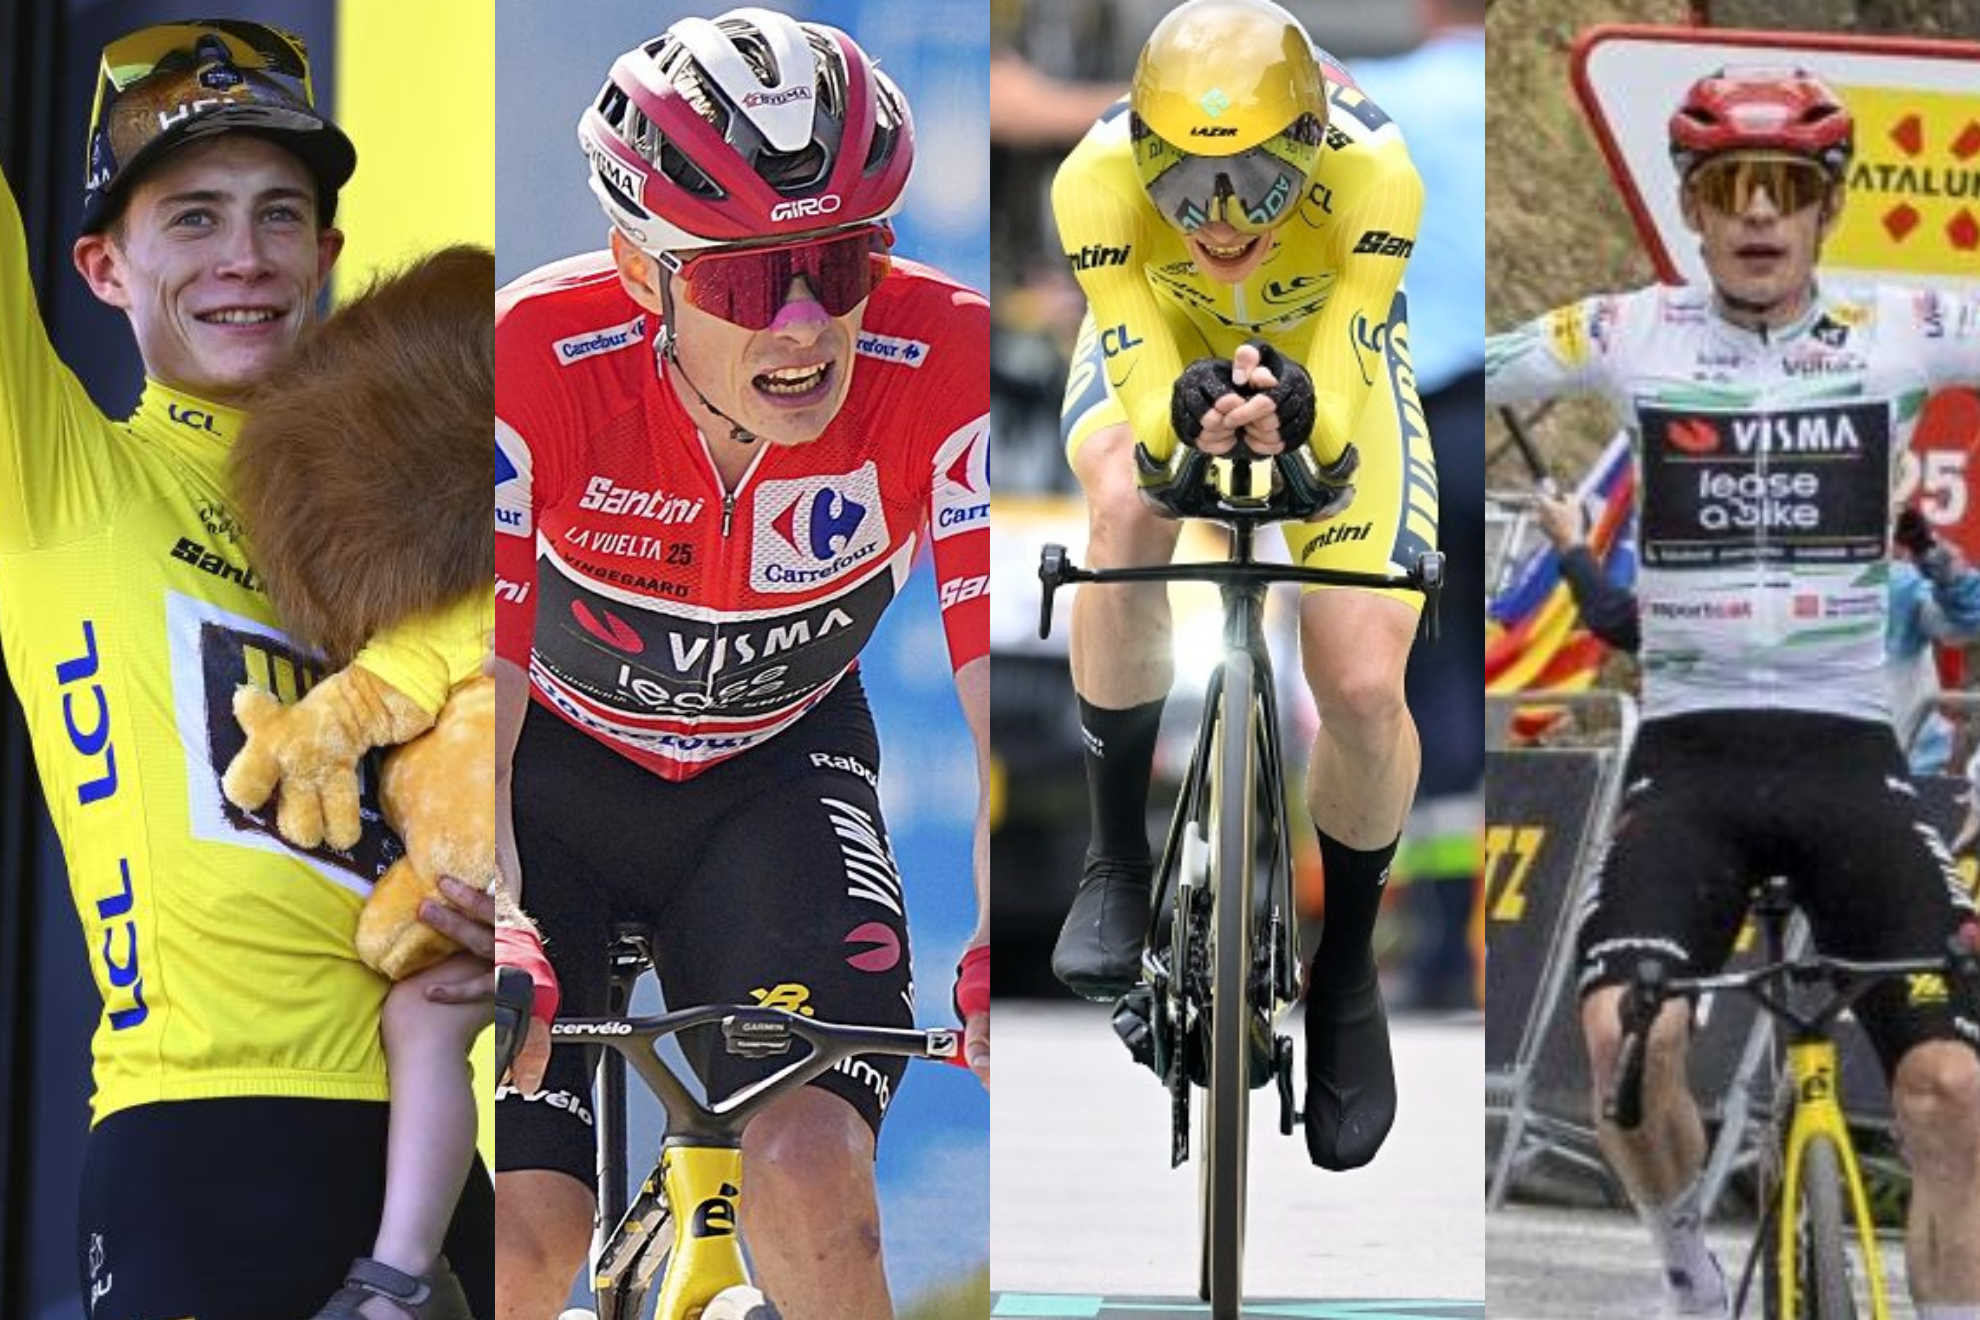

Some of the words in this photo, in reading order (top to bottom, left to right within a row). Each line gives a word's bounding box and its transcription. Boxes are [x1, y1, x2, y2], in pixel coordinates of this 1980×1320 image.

[1190, 126, 1239, 137] LAZER
[1850, 164, 1980, 198] ATALU
[771, 194, 841, 222] GIRO
[1066, 242, 1132, 270] ntini
[562, 333, 628, 358] Carrefour
[857, 338, 899, 357] refour
[1102, 323, 1144, 358] CL
[1358, 315, 1386, 352] LC
[168, 403, 223, 437] LCL
[1732, 414, 1860, 452] VISMA
[578, 475, 705, 526] Santini
[1700, 469, 1820, 500] lease
[938, 503, 990, 528] Carr
[564, 526, 590, 548] LA
[591, 532, 661, 561] VUELTA
[666, 542, 694, 567] 25
[763, 540, 879, 584] Carrefour
[170, 536, 267, 594] Sant
[564, 551, 689, 598] VINGEGAARD
[941, 574, 990, 612] Sa
[668, 606, 855, 674] VISMA
[56, 620, 118, 806] LCL
[809, 752, 878, 788] Rabo
[96, 857, 150, 1032] LCL
[551, 1022, 633, 1036] cervélo
[742, 1023, 785, 1031] GARMIN
[495, 1085, 593, 1127] rvélo
